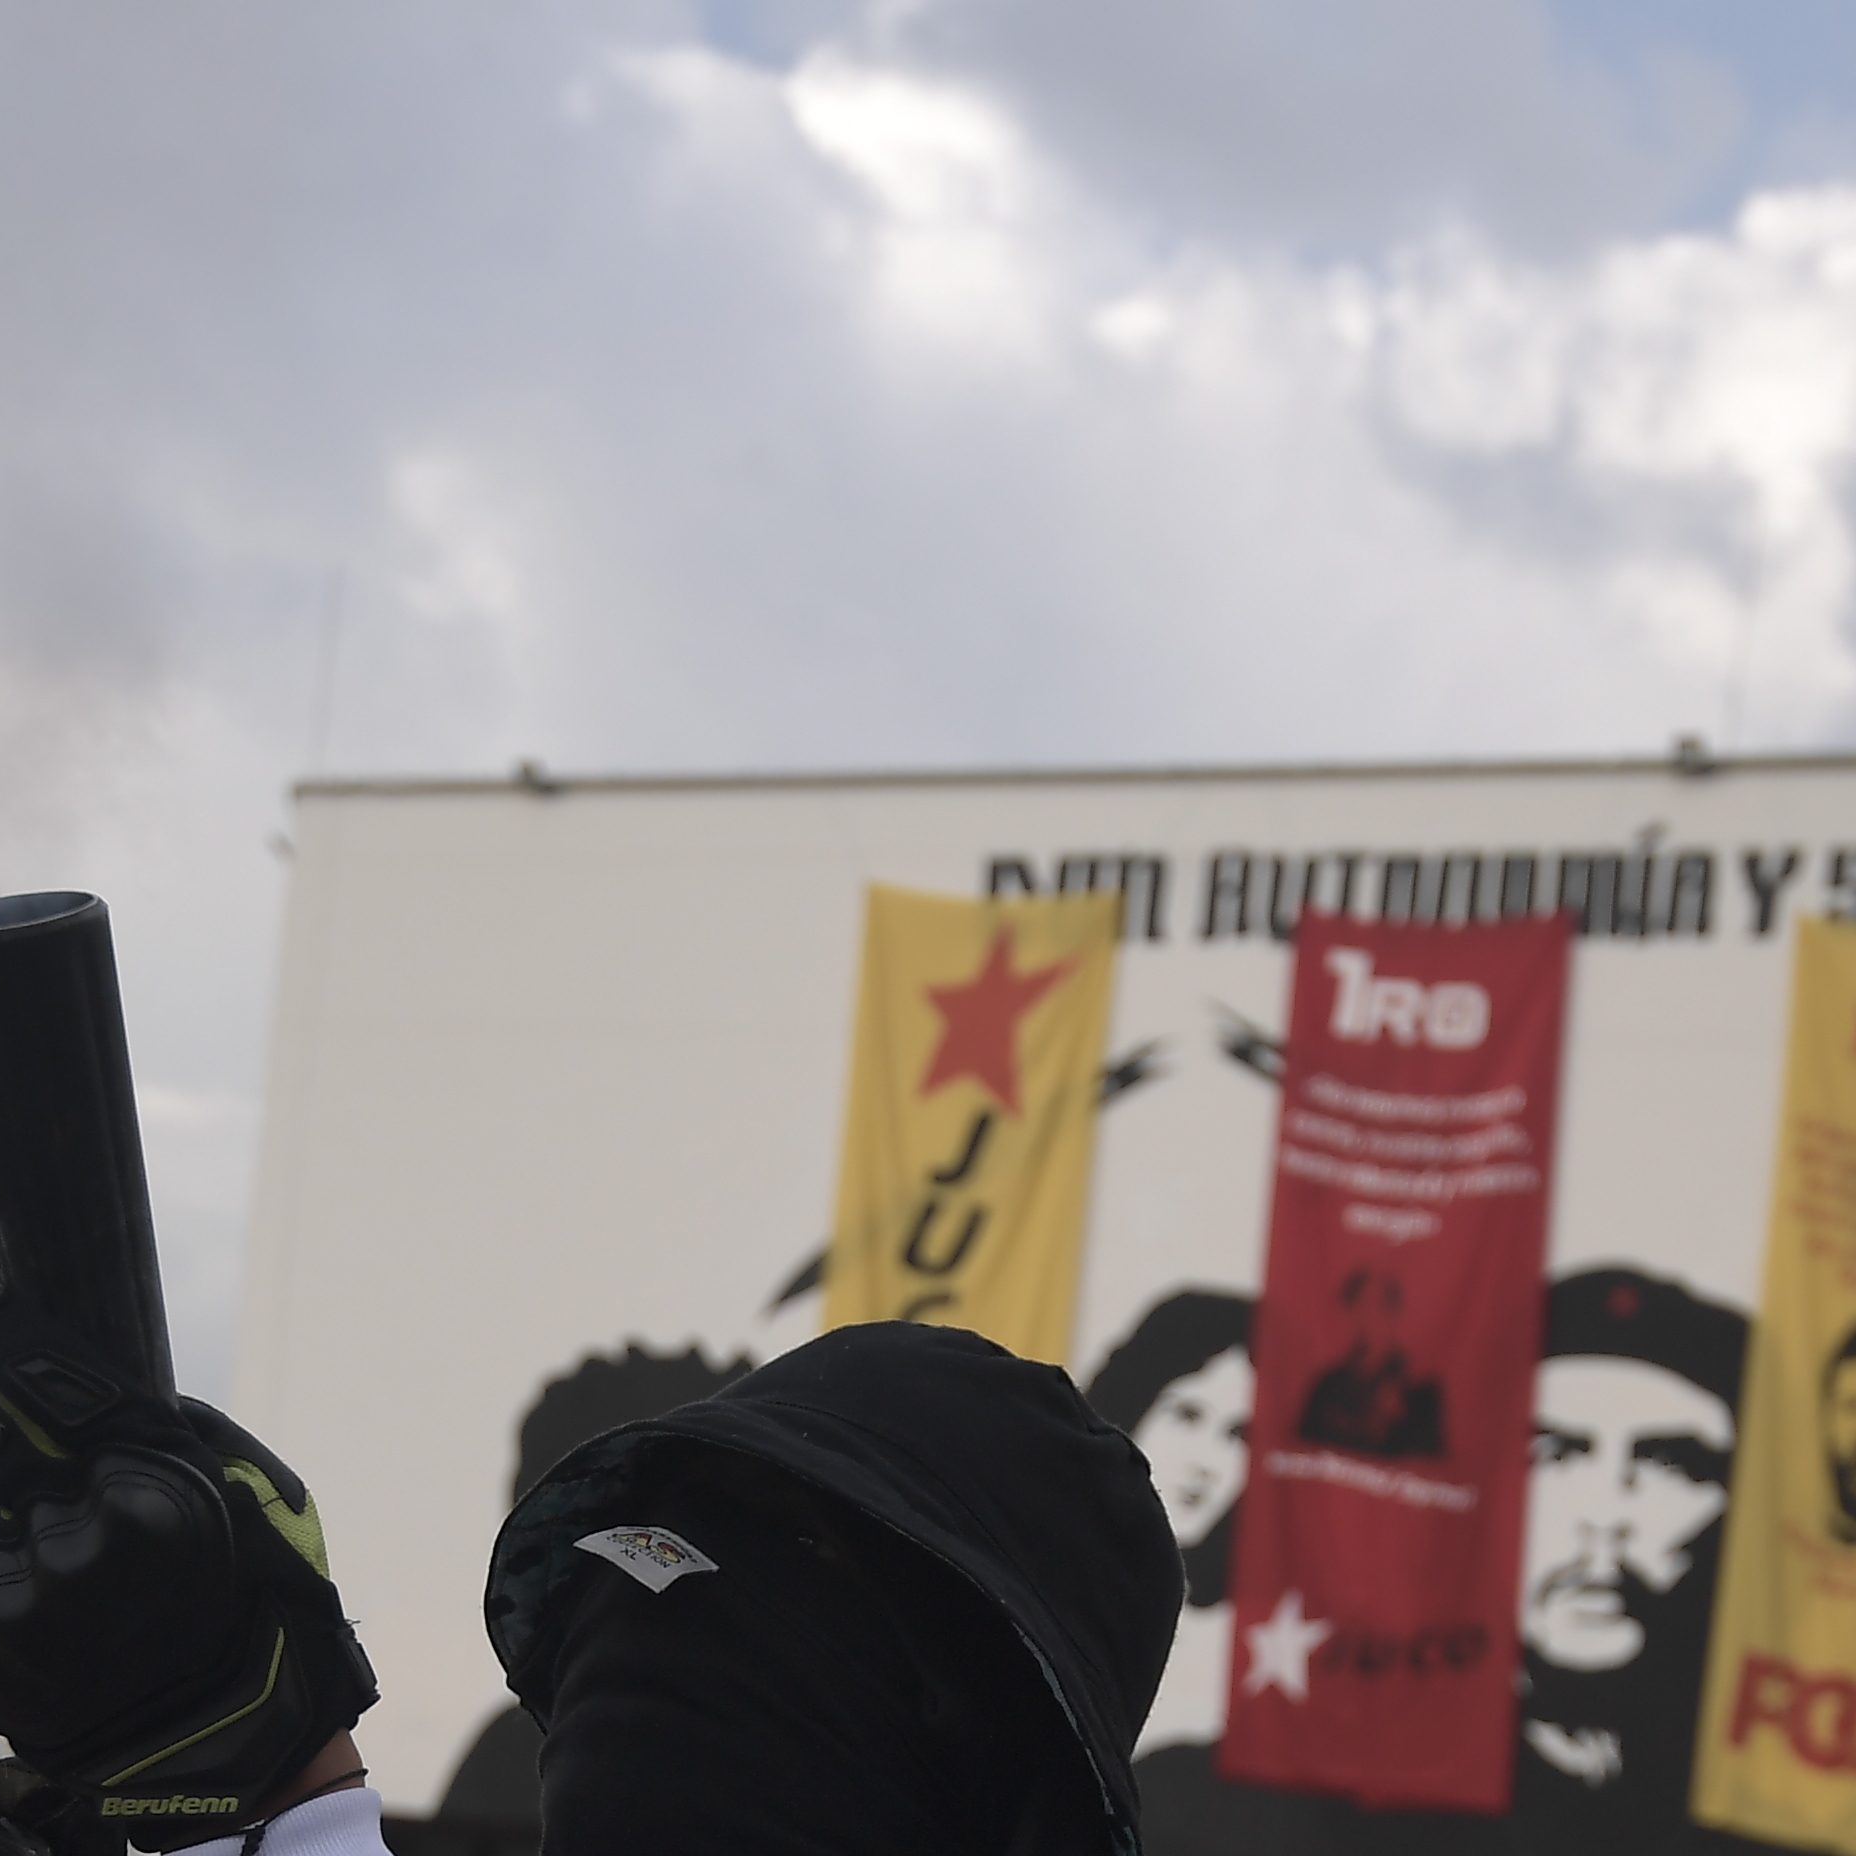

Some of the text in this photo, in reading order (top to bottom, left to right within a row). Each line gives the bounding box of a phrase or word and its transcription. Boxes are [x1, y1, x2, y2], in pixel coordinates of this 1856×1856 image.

[1744, 849, 1800, 938] Y
[902, 1106, 994, 1321] JU
[620, 1548, 636, 1561] XL
[1321, 1622, 1490, 1680] JUCO
[102, 1794, 239, 1816] Berufenn
